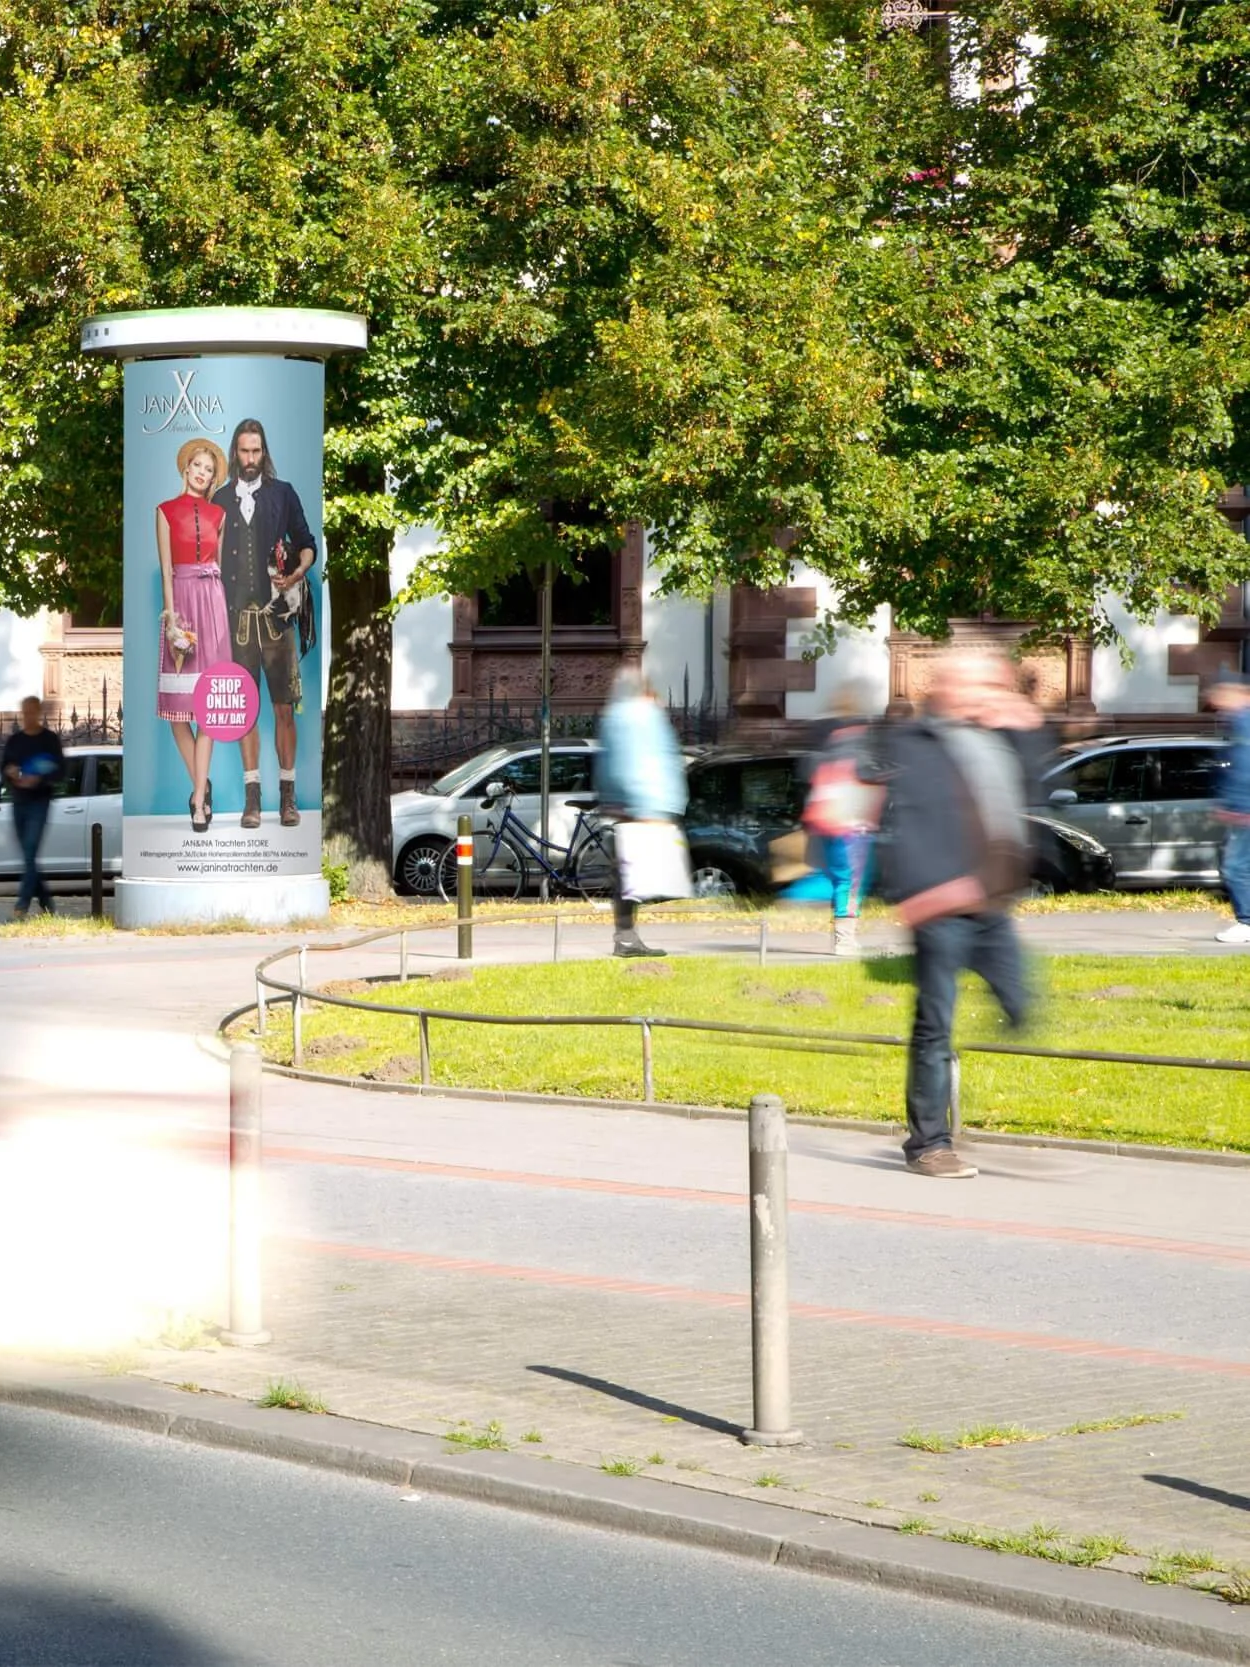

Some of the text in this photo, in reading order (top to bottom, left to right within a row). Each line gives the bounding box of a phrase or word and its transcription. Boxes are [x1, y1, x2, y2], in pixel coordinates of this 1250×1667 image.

[210, 678, 242, 693] SHOP
[206, 693, 246, 709] ONLINE
[206, 712, 217, 725] 24
[230, 712, 247, 725] DAY
[182, 839, 269, 848] JAN&INA Trachten STORE
[280, 849, 308, 858] München
[177, 863, 279, 874] www.janinatrachten.de
